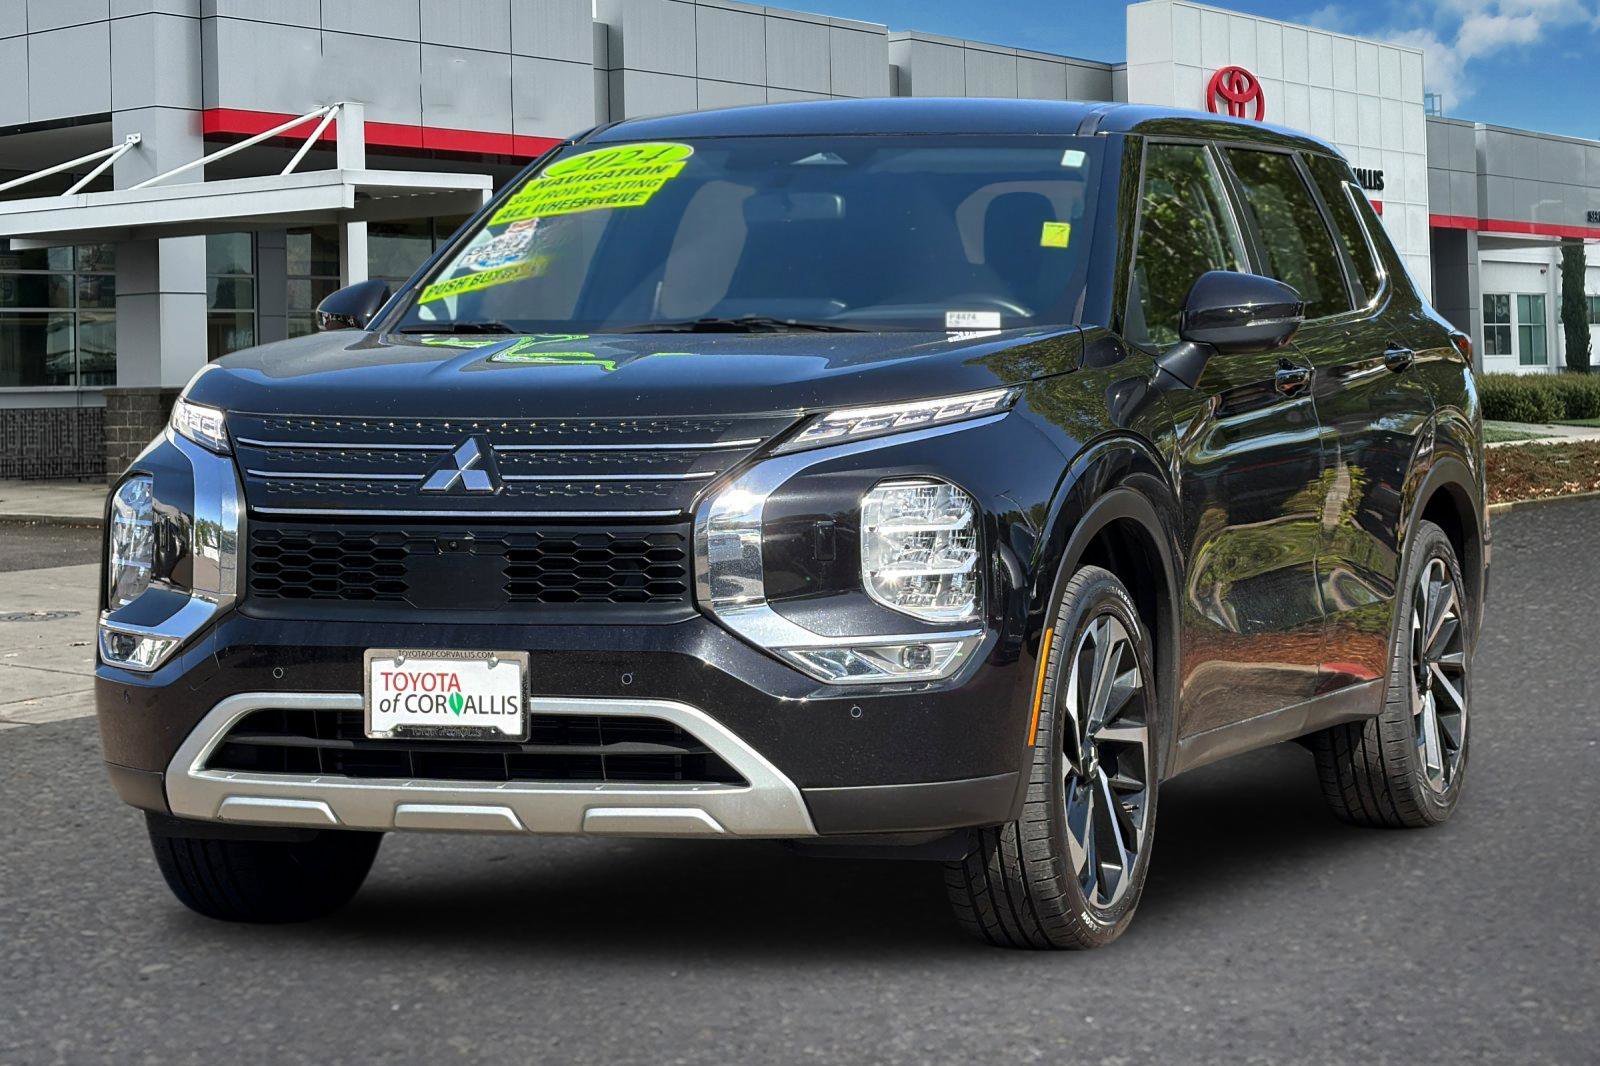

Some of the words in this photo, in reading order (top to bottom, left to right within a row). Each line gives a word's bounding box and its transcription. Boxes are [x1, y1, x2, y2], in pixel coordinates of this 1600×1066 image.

[533, 165, 672, 190] NAVIGATION
[542, 185, 588, 200] ROW
[586, 177, 662, 193] SEATING
[500, 205, 530, 219] ALL
[424, 276, 471, 299] PUSH
[399, 649, 496, 659] TOYOTAOFCORVALLIS.COM
[380, 672, 462, 692] TOYOTA
[379, 693, 402, 713] of
[404, 692, 518, 717] CORVALLIS
